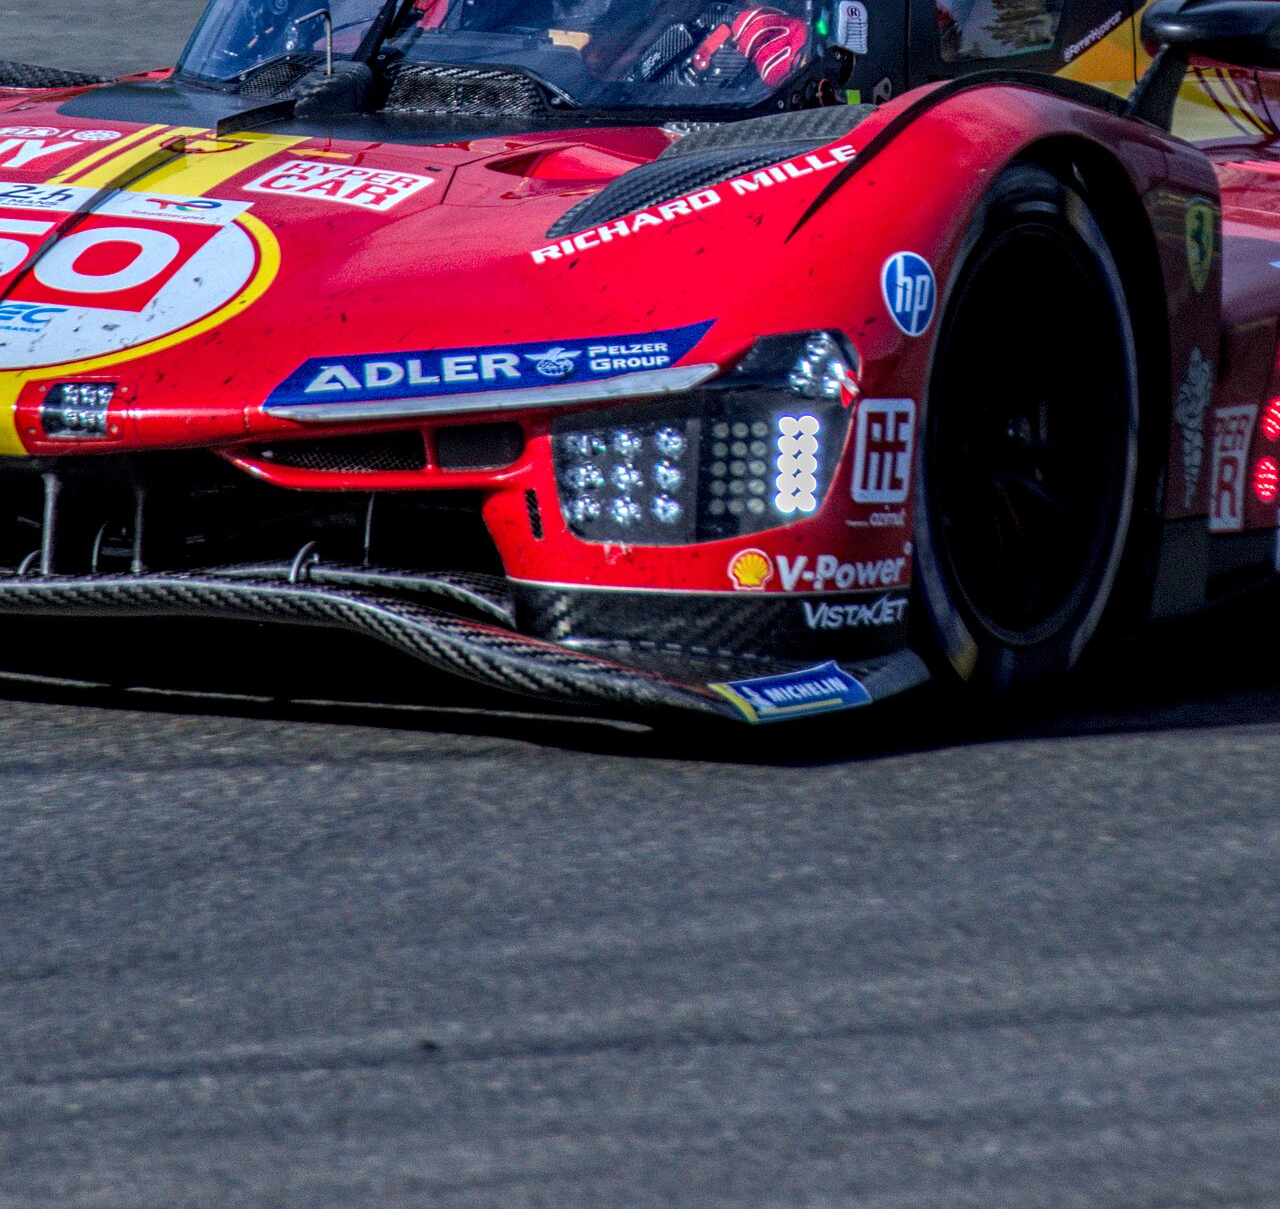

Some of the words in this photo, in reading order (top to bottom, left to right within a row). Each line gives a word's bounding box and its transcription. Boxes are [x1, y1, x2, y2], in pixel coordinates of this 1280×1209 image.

[259, 173, 399, 206] CAR
[282, 163, 420, 189] HYPER
[7, 197, 60, 207] MANS
[531, 189, 721, 264] RICHARD
[730, 144, 858, 196] MILLE
[895, 254, 931, 334] hp
[588, 342, 669, 357] PELZER
[590, 355, 671, 371] GROUP
[304, 353, 521, 393] ADLER
[776, 554, 906, 591] V-Power
[763, 676, 850, 703] MICHELIN
